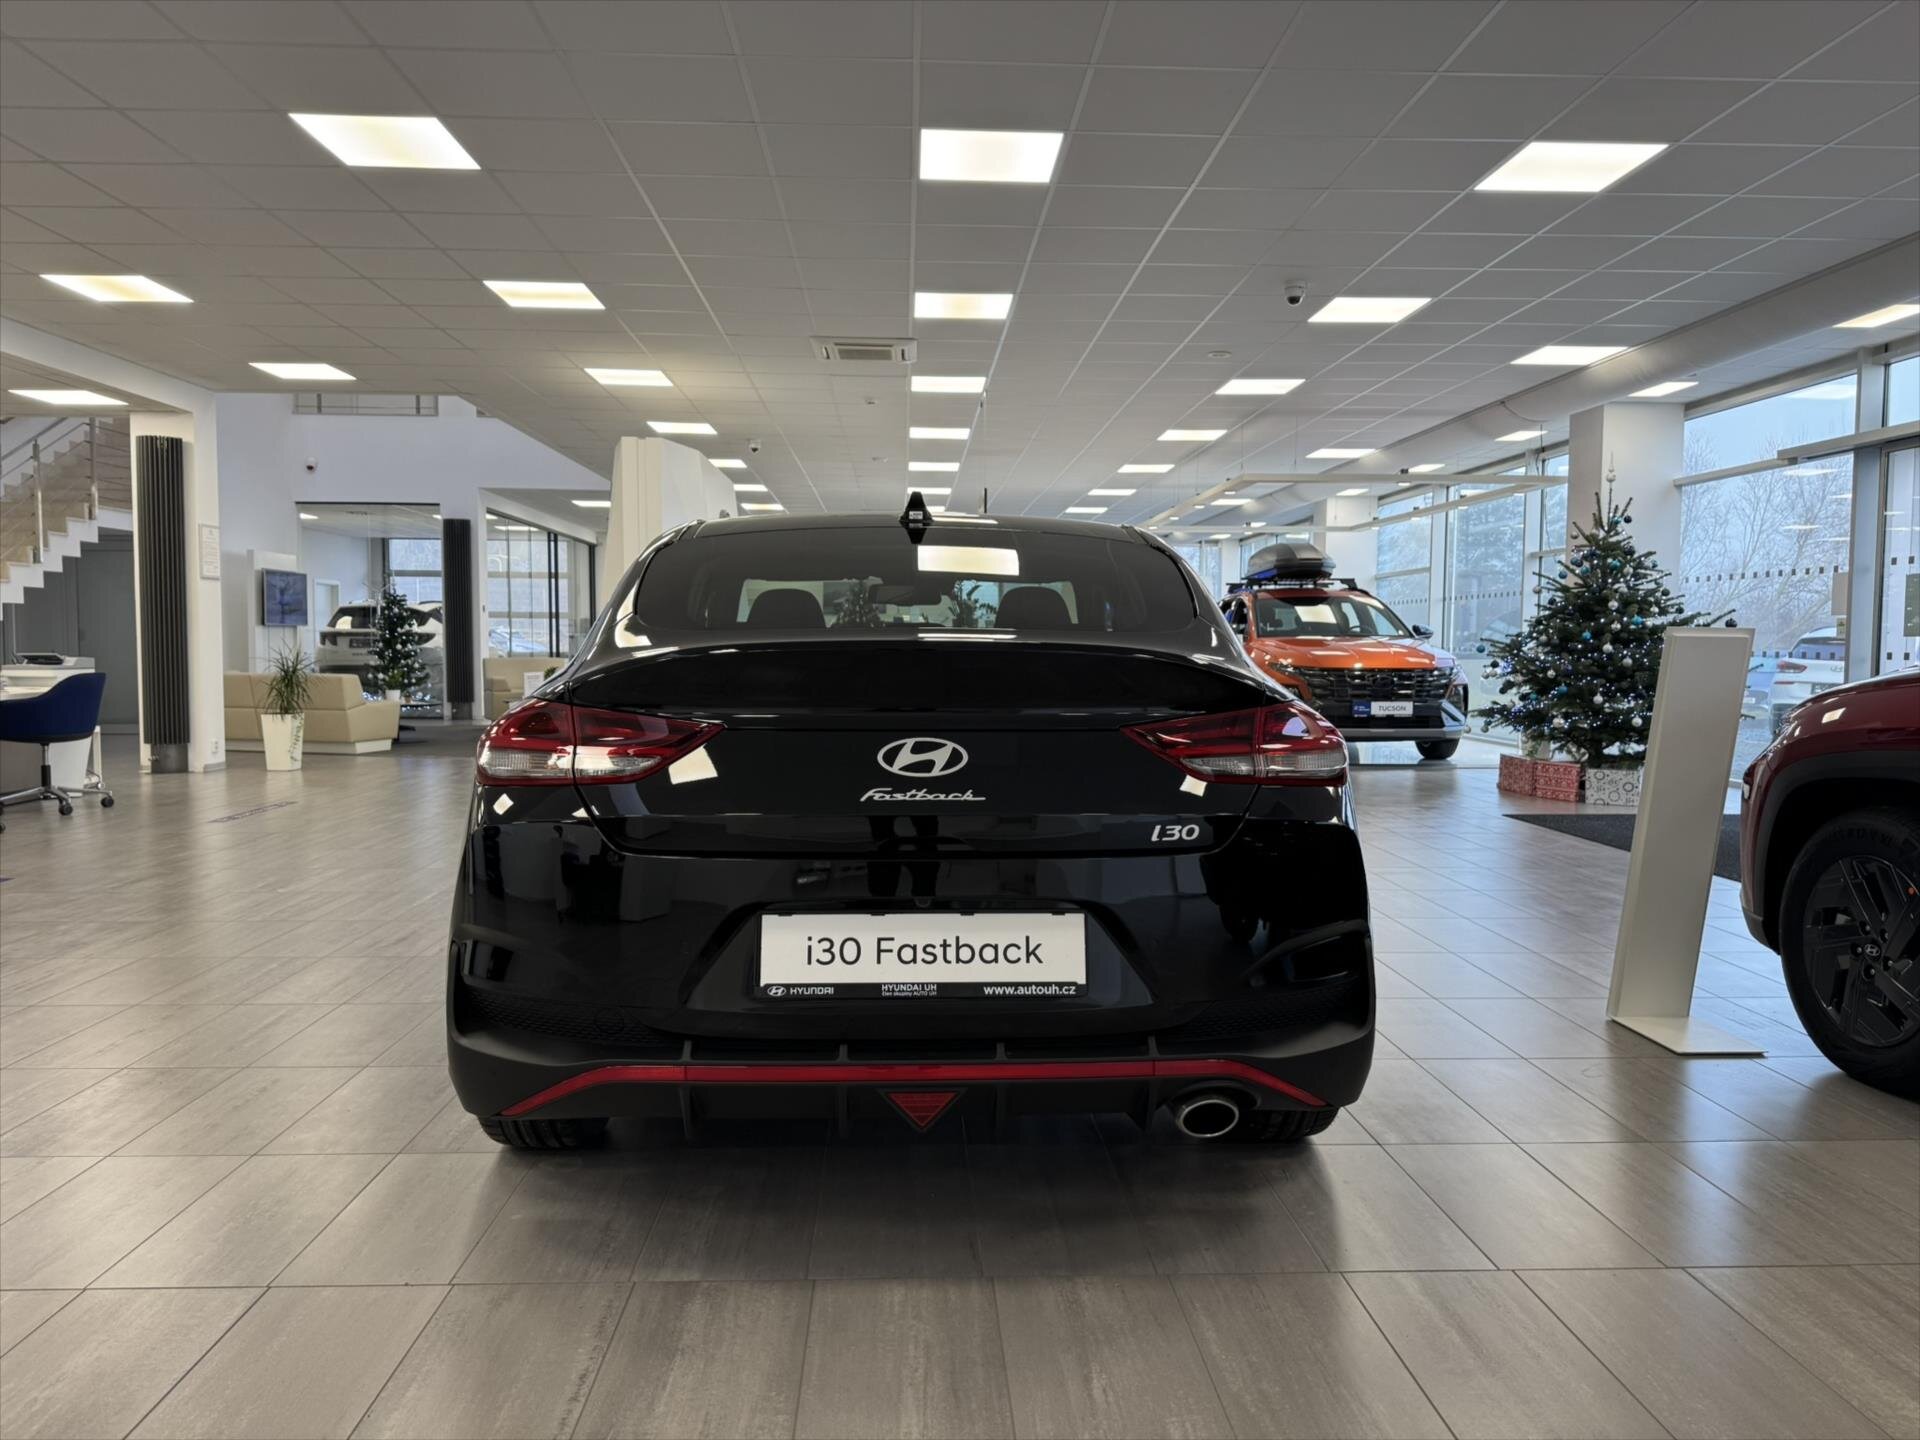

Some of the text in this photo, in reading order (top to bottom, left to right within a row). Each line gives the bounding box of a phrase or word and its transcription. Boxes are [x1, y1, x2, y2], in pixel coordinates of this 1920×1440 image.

[860, 787, 986, 801] Fastback
[806, 935, 1044, 966] i30 Fastback
[790, 986, 834, 995] HYUNDAI
[983, 983, 1077, 995] www.autouh.cz
